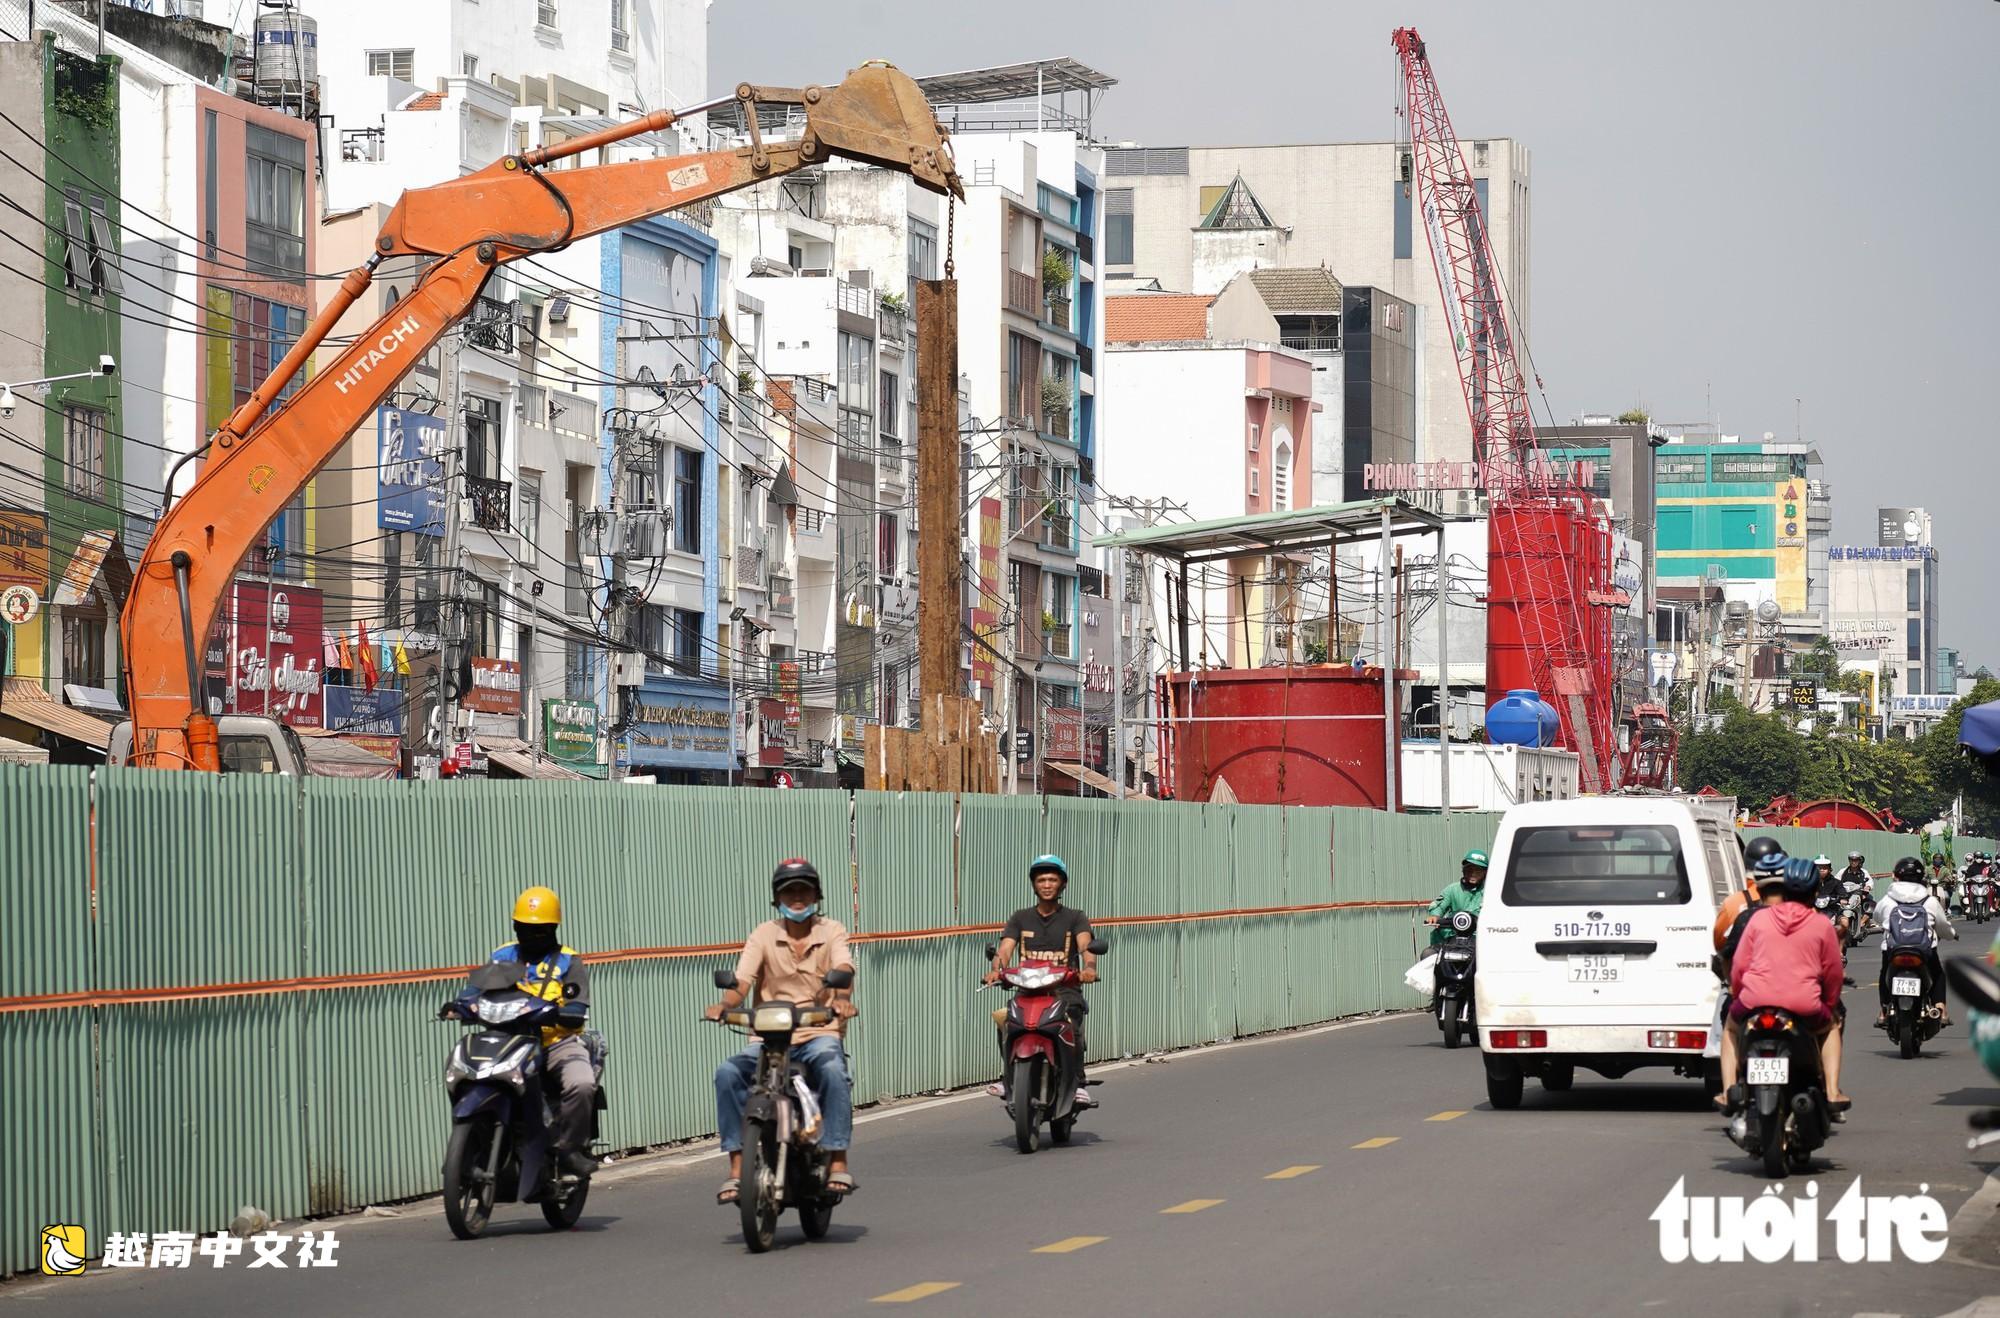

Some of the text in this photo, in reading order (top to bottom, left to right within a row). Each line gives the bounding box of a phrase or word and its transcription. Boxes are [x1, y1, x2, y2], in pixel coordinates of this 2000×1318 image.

[334, 315, 421, 394] HITACHI
[1363, 457, 1418, 490] PHÒNG
[1422, 456, 1463, 490] TIÊM
[1834, 620, 1856, 632] NHA
[1893, 697, 1915, 710] THE
[1486, 926, 1519, 934] THACO
[1554, 922, 1631, 937] 51D-717.99
[1583, 956, 1608, 968] 51D
[1676, 961, 1695, 969] VAN
[1574, 969, 1618, 981] 717.99
